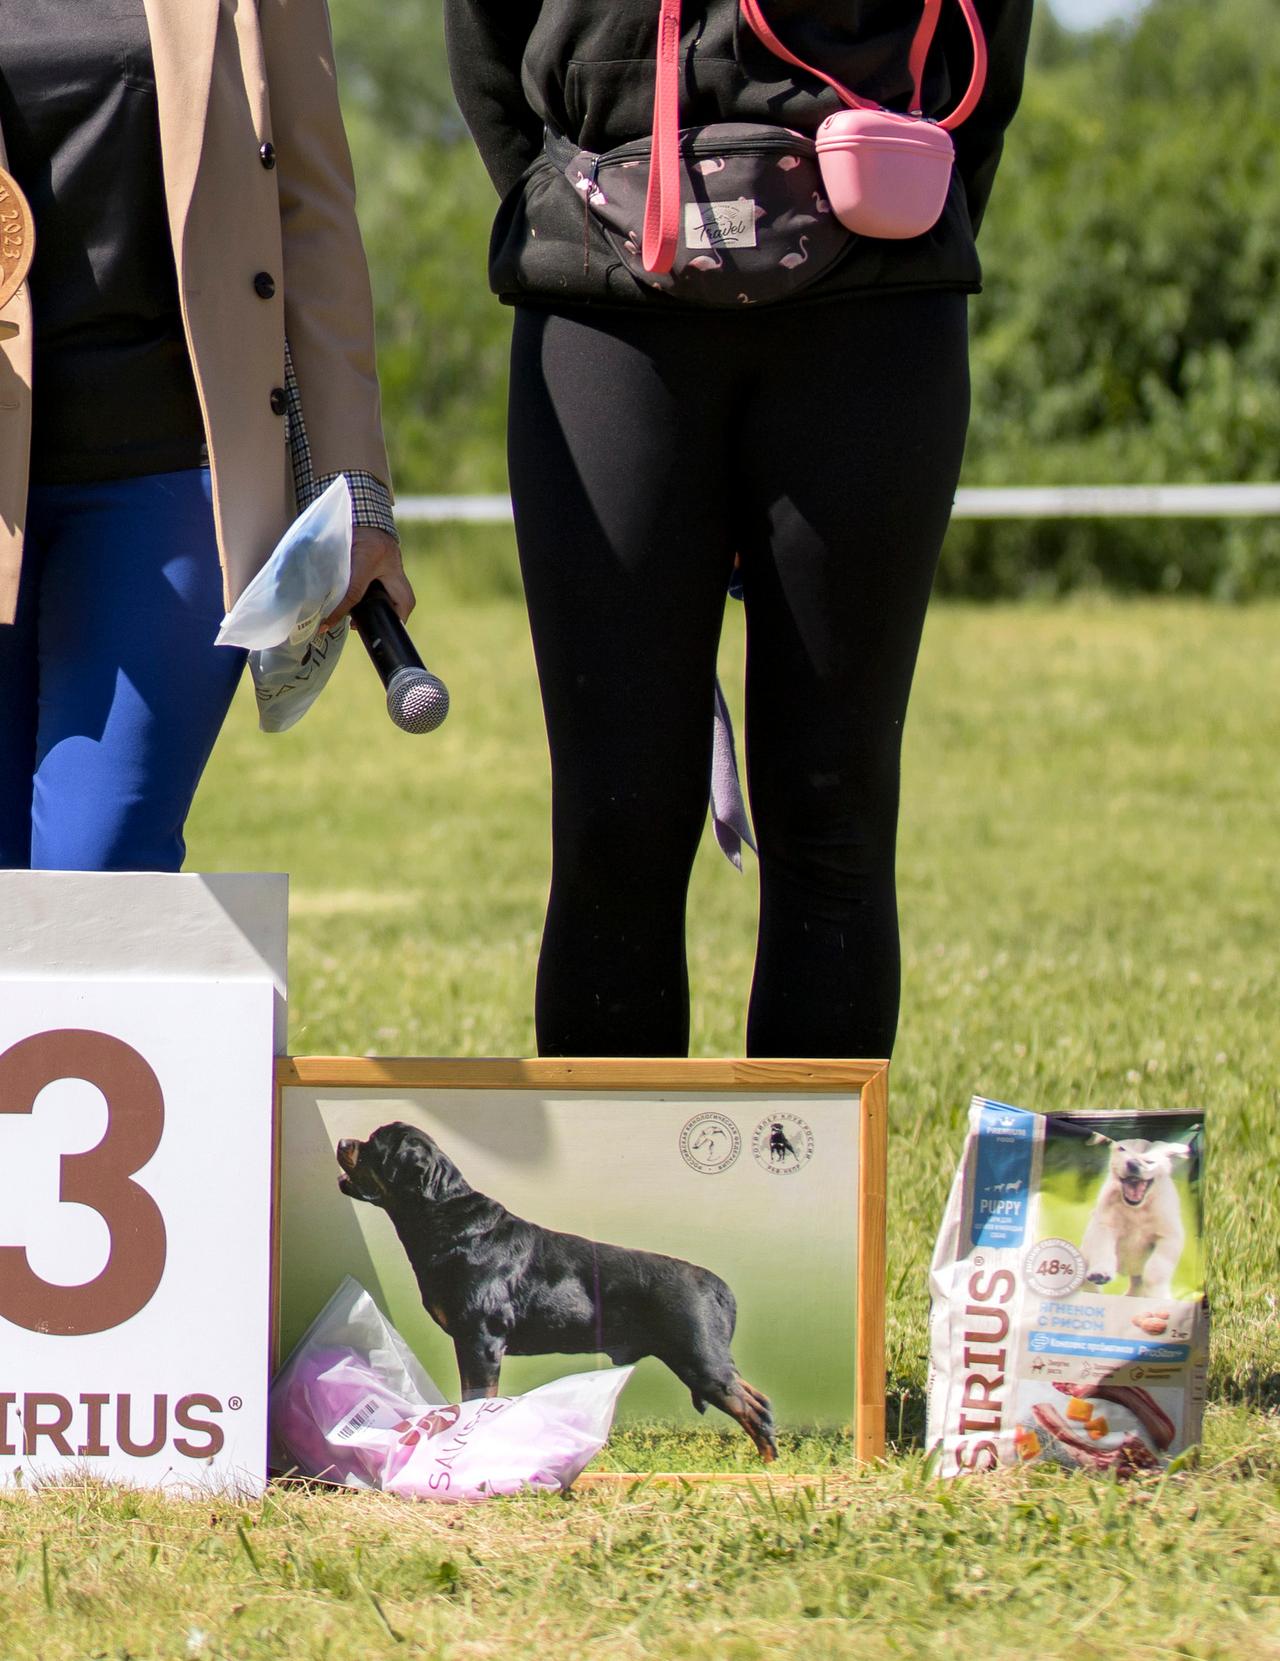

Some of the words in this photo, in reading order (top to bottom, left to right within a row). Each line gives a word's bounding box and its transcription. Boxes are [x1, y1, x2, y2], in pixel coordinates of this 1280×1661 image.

[0, 209, 24, 260] 2023
[693, 220, 746, 242] Travel
[718, 1136, 740, 1171] ФЕДЕРАЦИЯ
[980, 1199, 1022, 1216] PUPPY
[1035, 1259, 1074, 1276] 48%
[1051, 1316, 1105, 1331] РИСОМ
